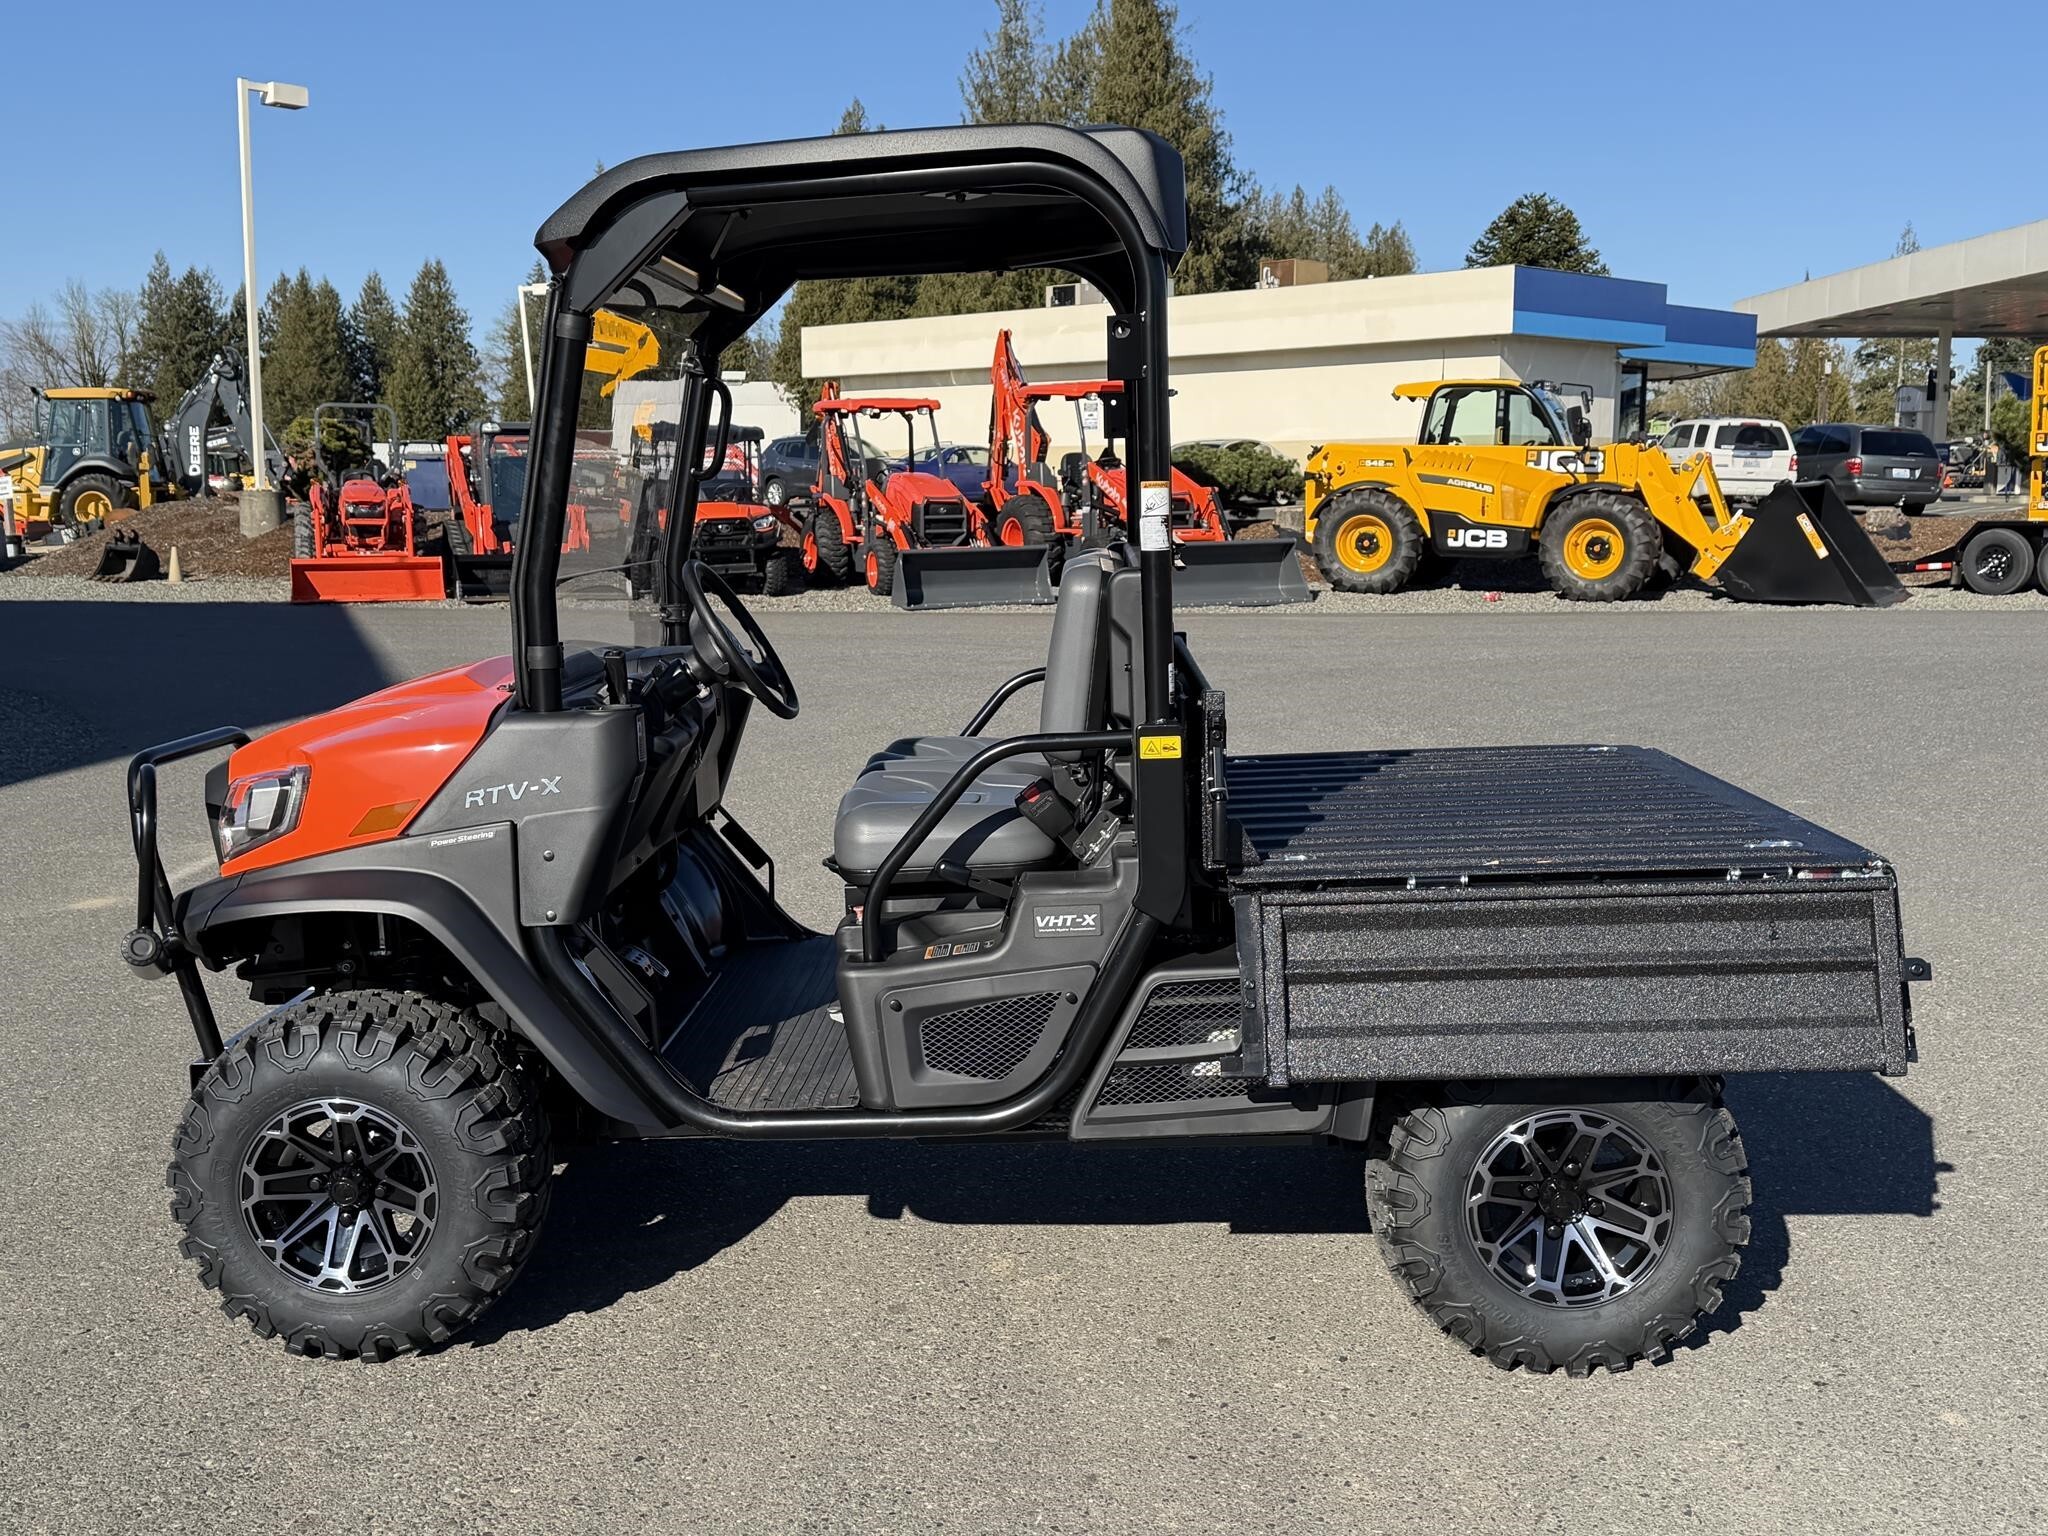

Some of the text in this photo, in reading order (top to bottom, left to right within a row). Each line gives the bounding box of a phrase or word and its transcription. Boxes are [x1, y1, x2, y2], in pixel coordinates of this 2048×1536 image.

[189, 426, 201, 476] DEERE
[1527, 450, 1605, 474] JCB
[1447, 529, 1508, 548] JCB
[465, 775, 562, 808] RTV-X
[431, 831, 494, 847] Power Steering
[1036, 914, 1098, 928] VHT-X
